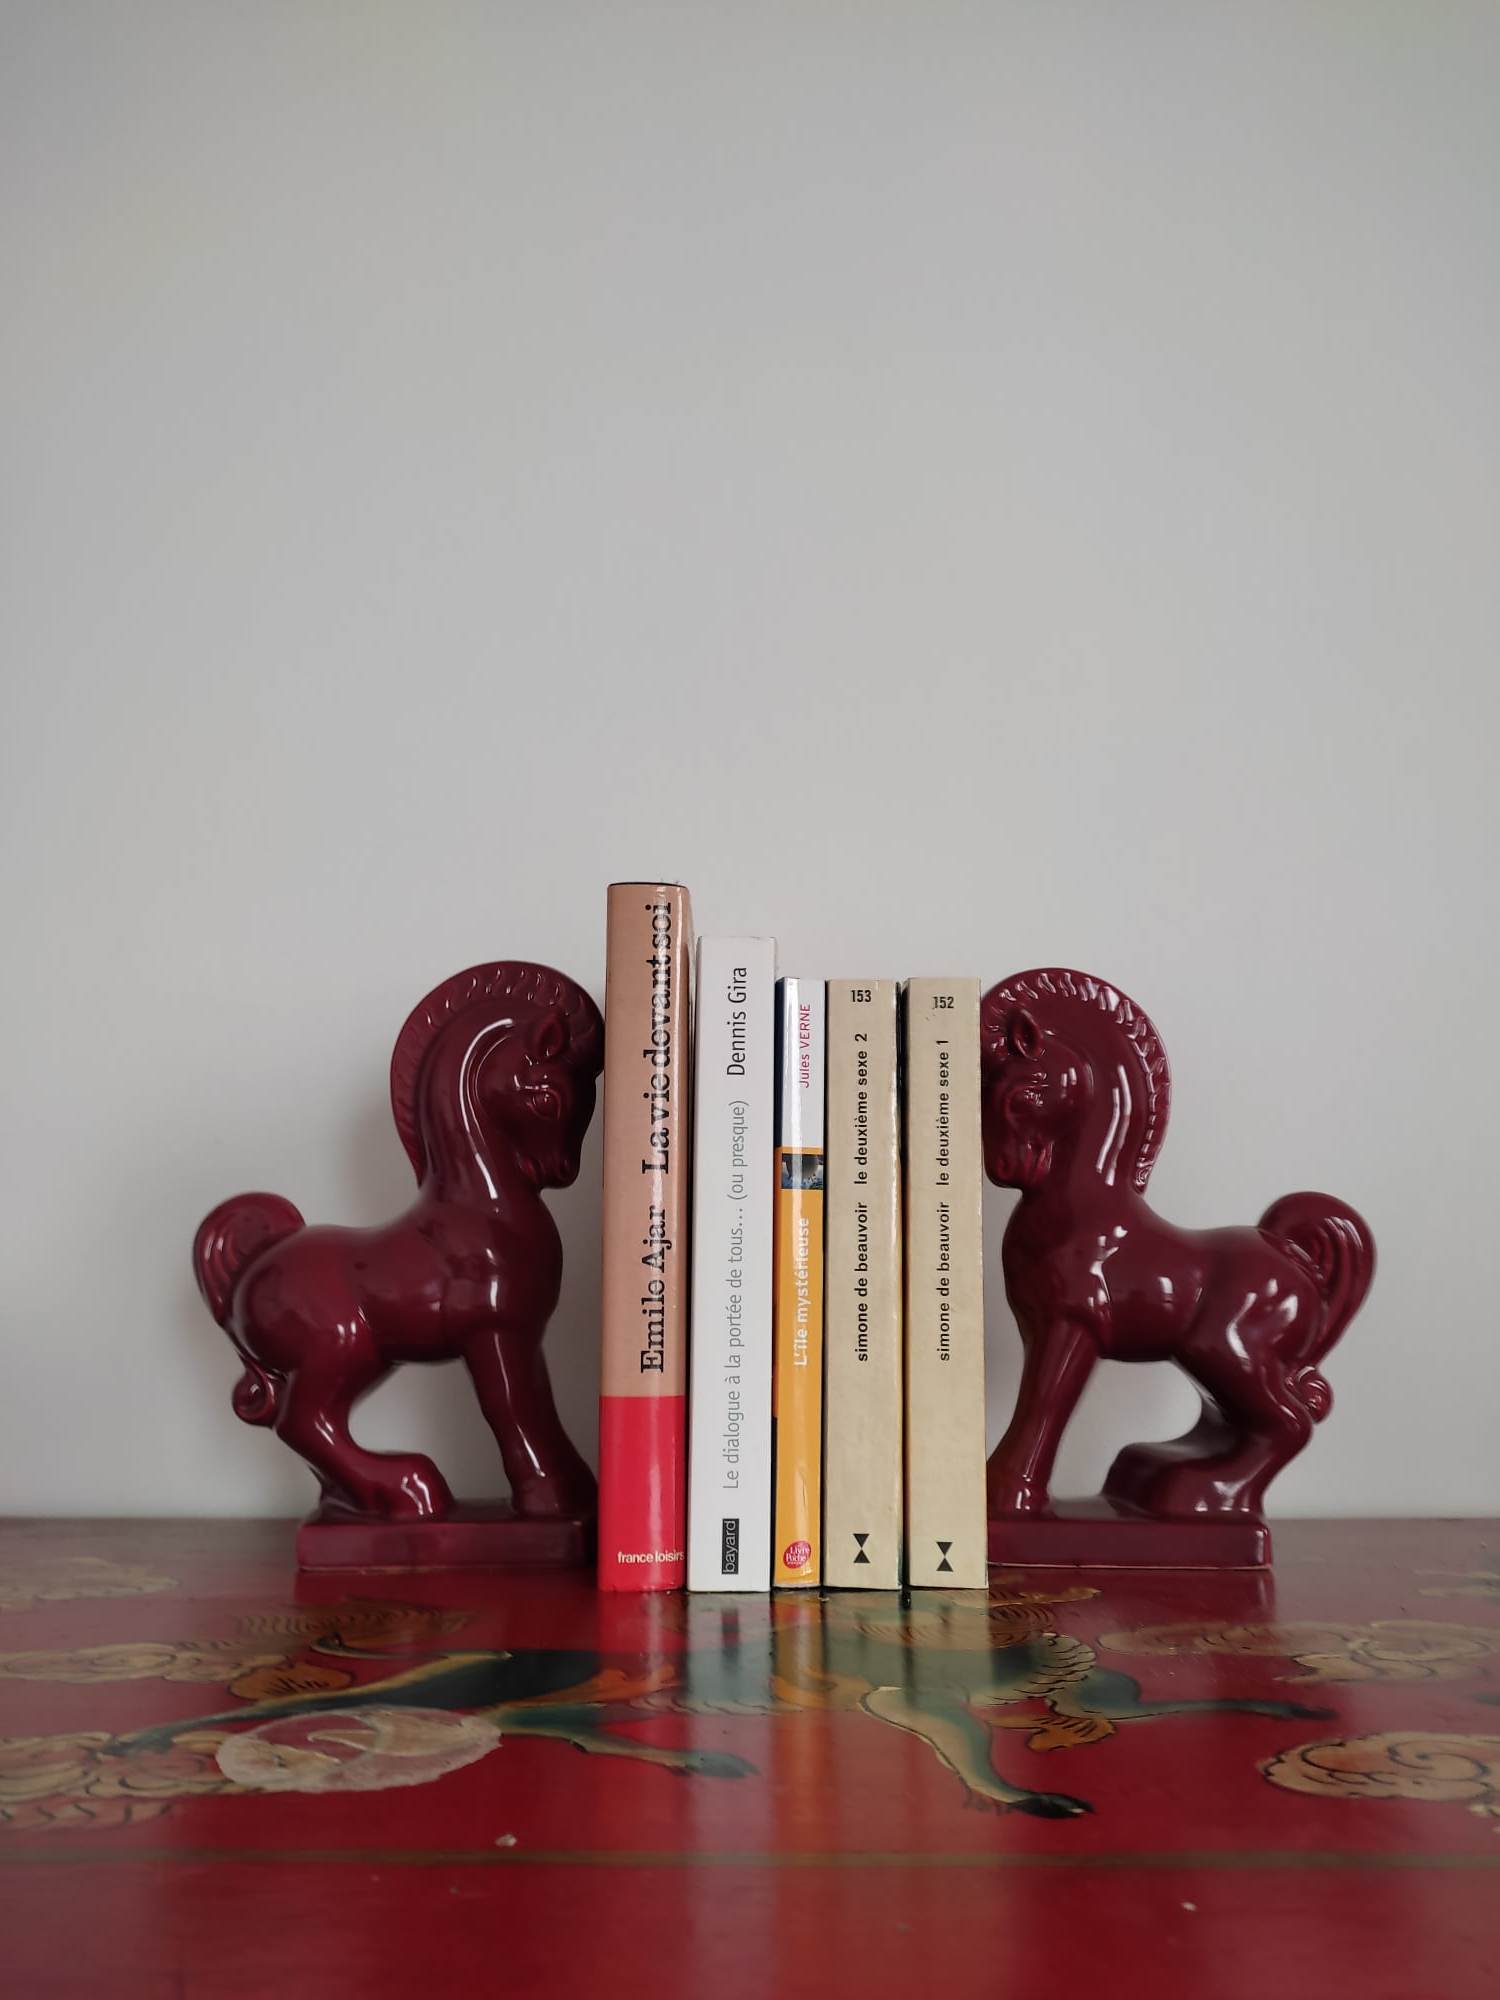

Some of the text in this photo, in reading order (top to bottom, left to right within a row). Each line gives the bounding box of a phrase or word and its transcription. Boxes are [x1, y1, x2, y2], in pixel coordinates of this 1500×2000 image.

[727, 967, 747, 1077] Dennis Gira
[851, 989, 872, 1003] 153
[933, 996, 954, 1009] 152
[642, 902, 671, 1174] La vie devant soi
[800, 1003, 811, 1089] Jules VERNE
[939, 1051, 949, 1087] sexe
[728, 1101, 749, 1168] presque)
[854, 1033, 868, 1185] le deuxième sexe 2
[936, 1091, 949, 1167] deuxième
[727, 1174, 748, 1200] (ou
[936, 1172, 949, 1185] le
[641, 1205, 672, 1373] Emile Ajar
[725, 1268, 742, 1288] de
[794, 1218, 812, 1322] mystérieuse
[854, 1202, 868, 1362] simone de beauvoir
[936, 1202, 950, 1361] simone de beauvoir
[724, 1294, 744, 1348] portée
[724, 1353, 741, 1369] la
[724, 1375, 740, 1385] à
[723, 1391, 744, 1464] dialogue
[723, 1470, 739, 1489] Le
[617, 1549, 685, 1563] france loisirs
[722, 1520, 739, 1573] bayard
